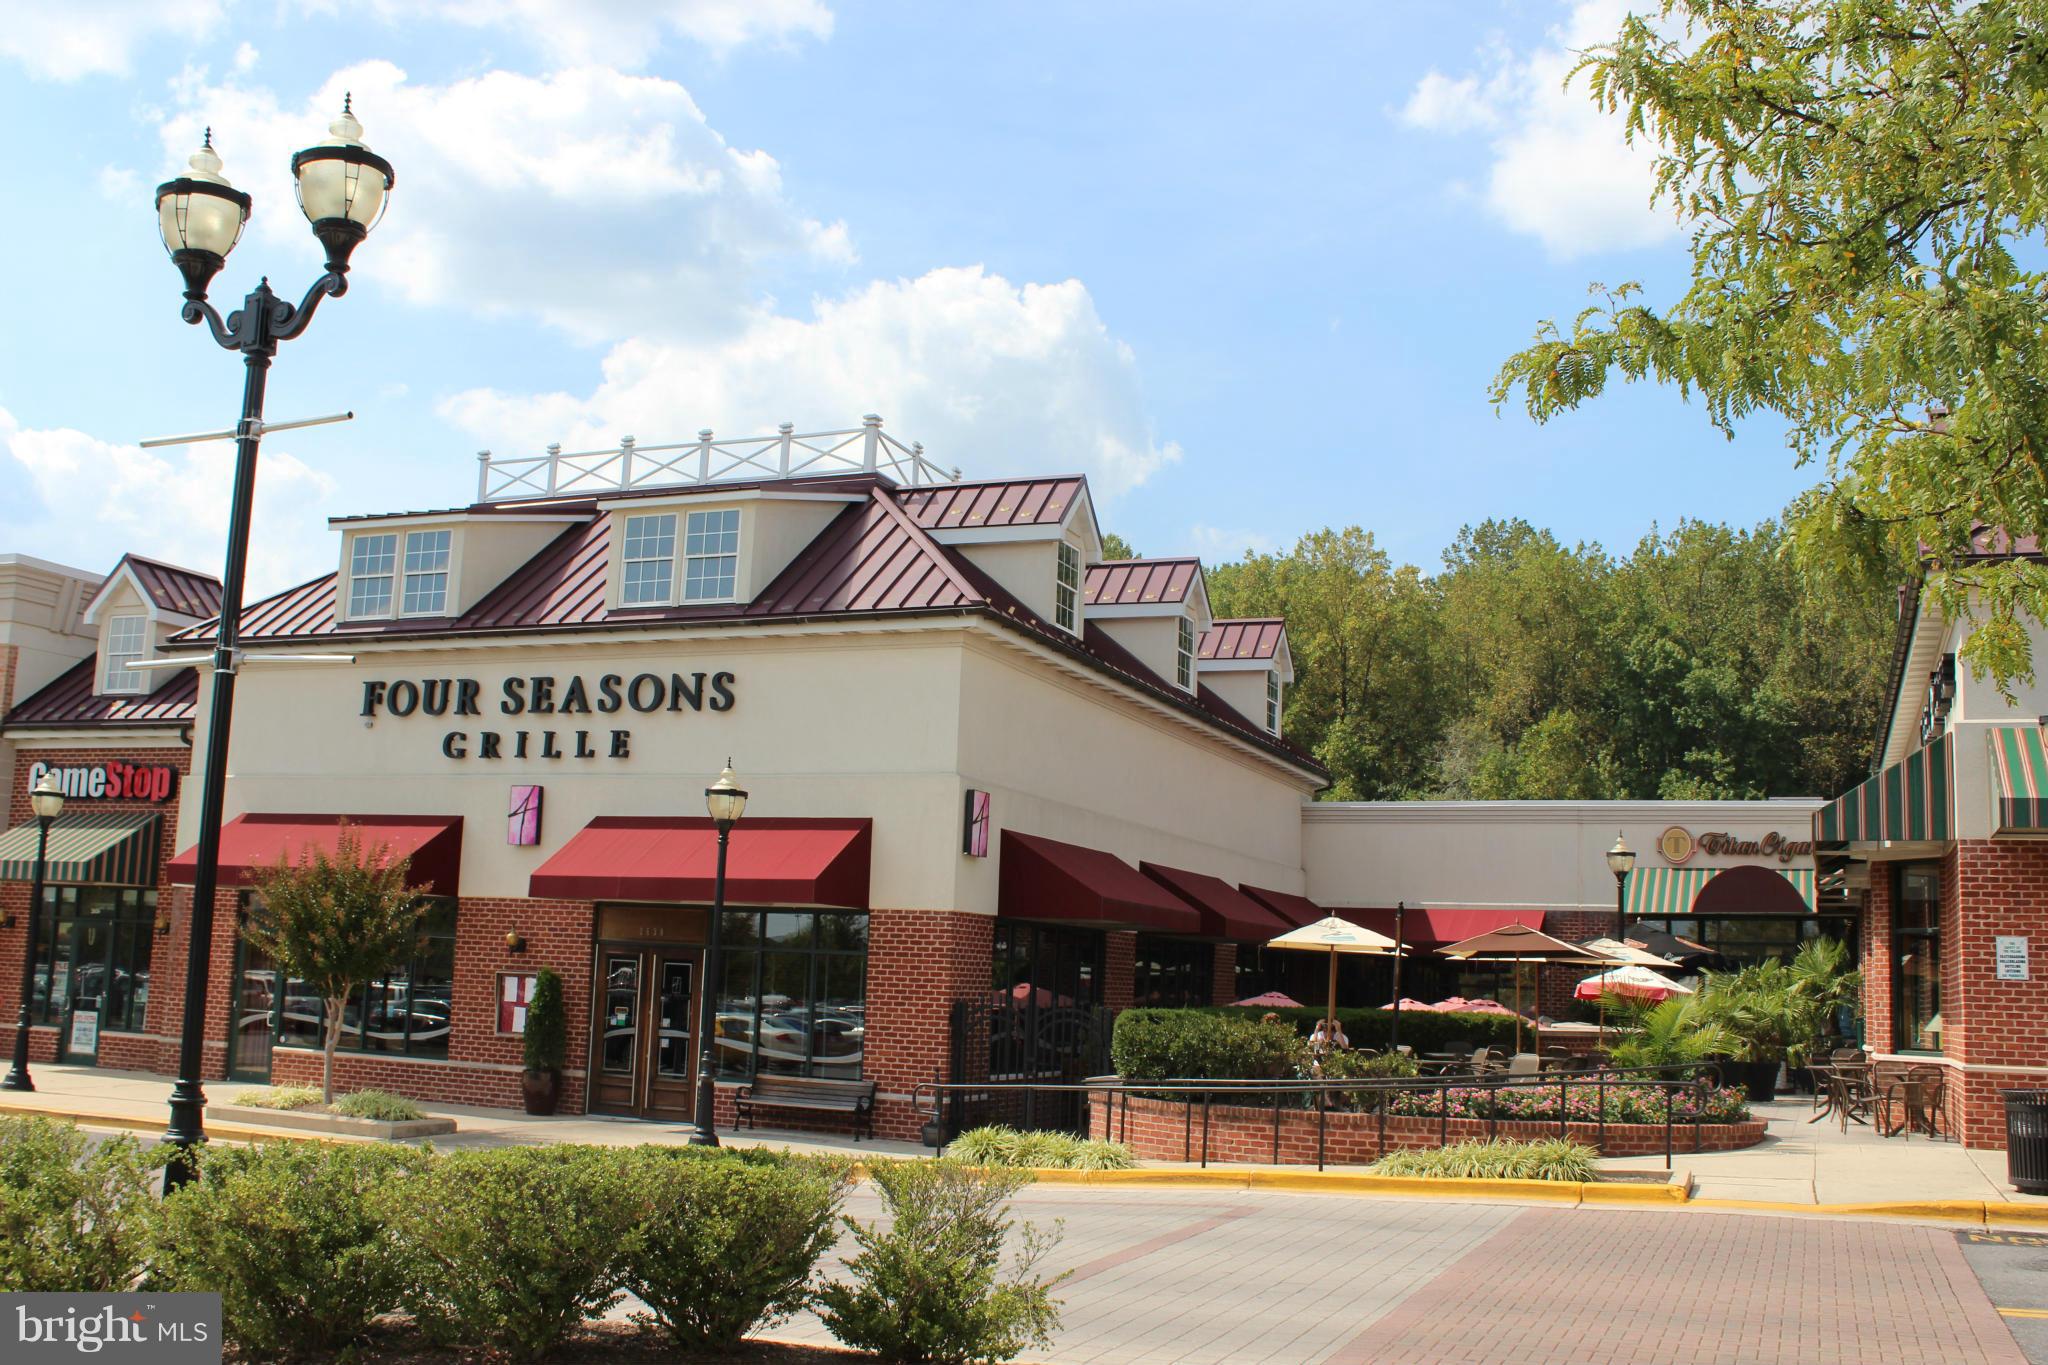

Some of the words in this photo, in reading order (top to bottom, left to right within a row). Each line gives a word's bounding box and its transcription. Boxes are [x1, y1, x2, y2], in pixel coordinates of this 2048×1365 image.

[360, 678, 482, 717] FOUR
[500, 671, 735, 715] SEASONS
[442, 729, 631, 759] GRILLE
[1699, 831, 1760, 856] Titan
